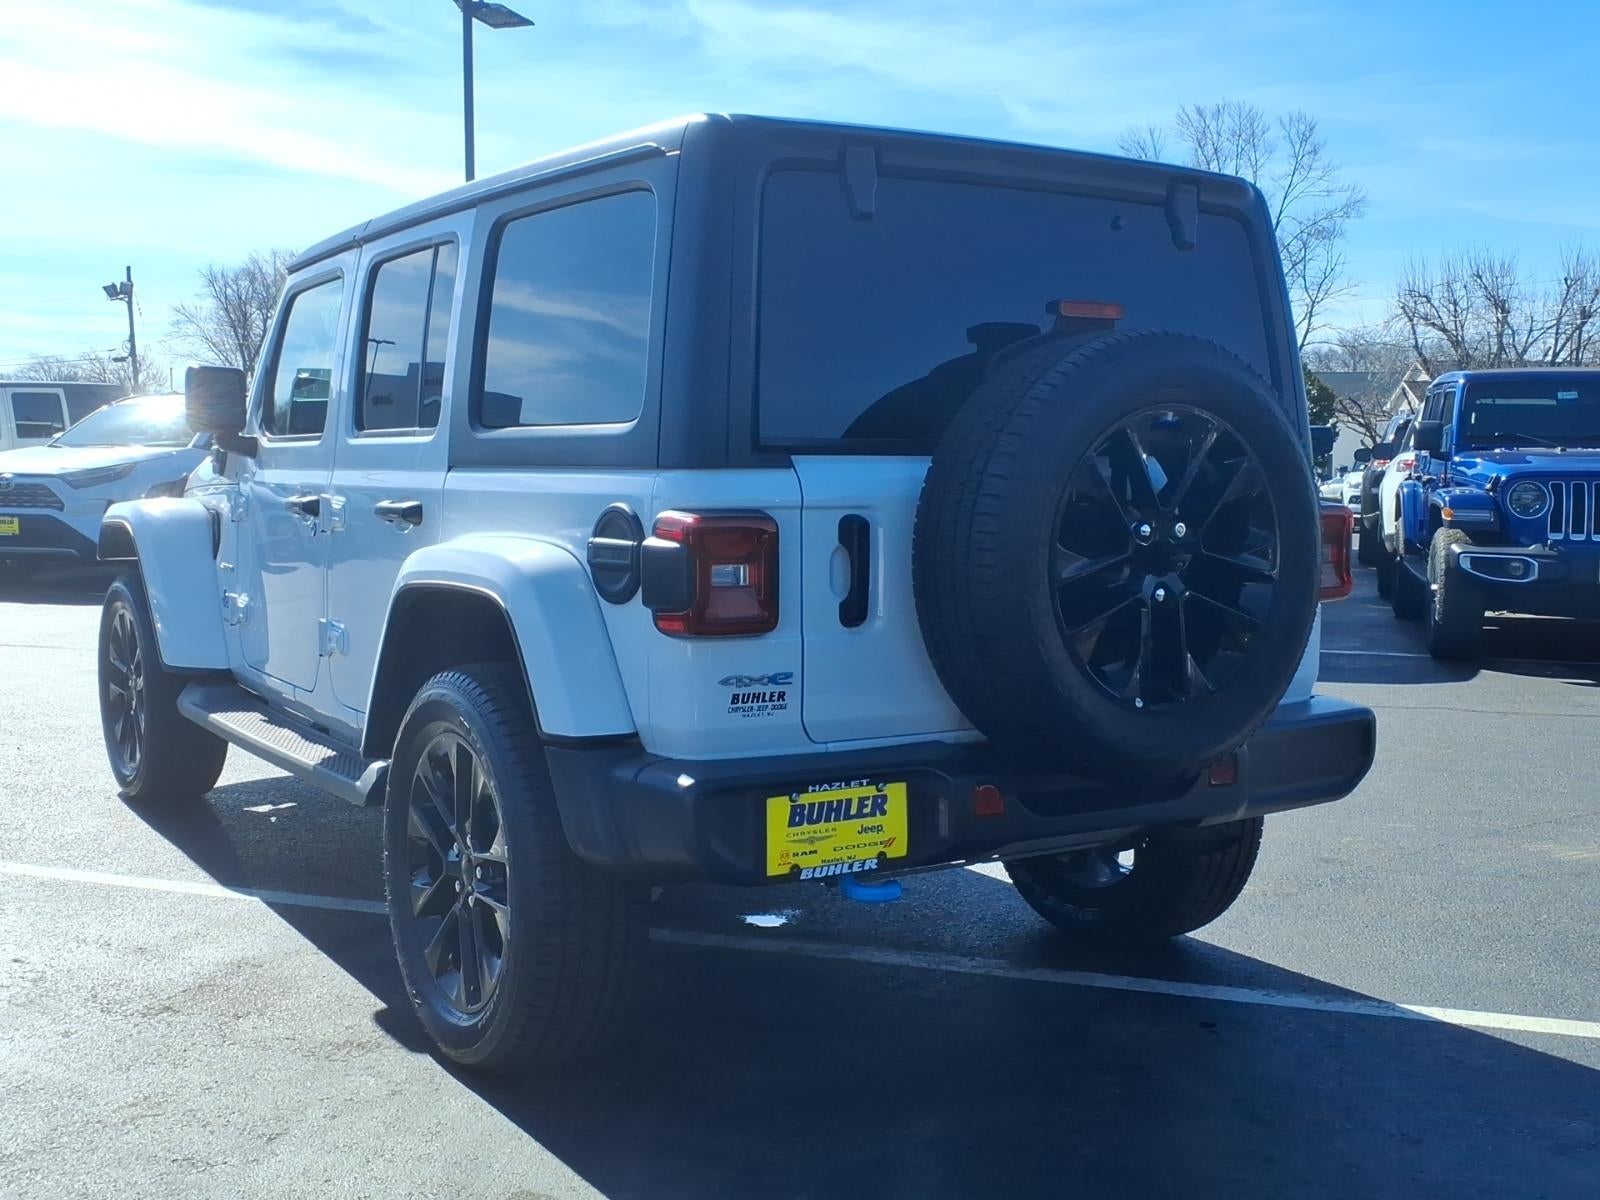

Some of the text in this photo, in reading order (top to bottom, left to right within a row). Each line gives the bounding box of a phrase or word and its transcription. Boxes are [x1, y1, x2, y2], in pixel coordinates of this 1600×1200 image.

[730, 691, 786, 705] BUHLER
[808, 779, 870, 793] HAZLET
[787, 794, 888, 828] BUHLER
[785, 827, 838, 839] CHRYSLER
[857, 824, 884, 835] Jeep
[833, 840, 888, 851] DODGE
[792, 849, 818, 858] RAM
[800, 858, 879, 880] BUHLER
